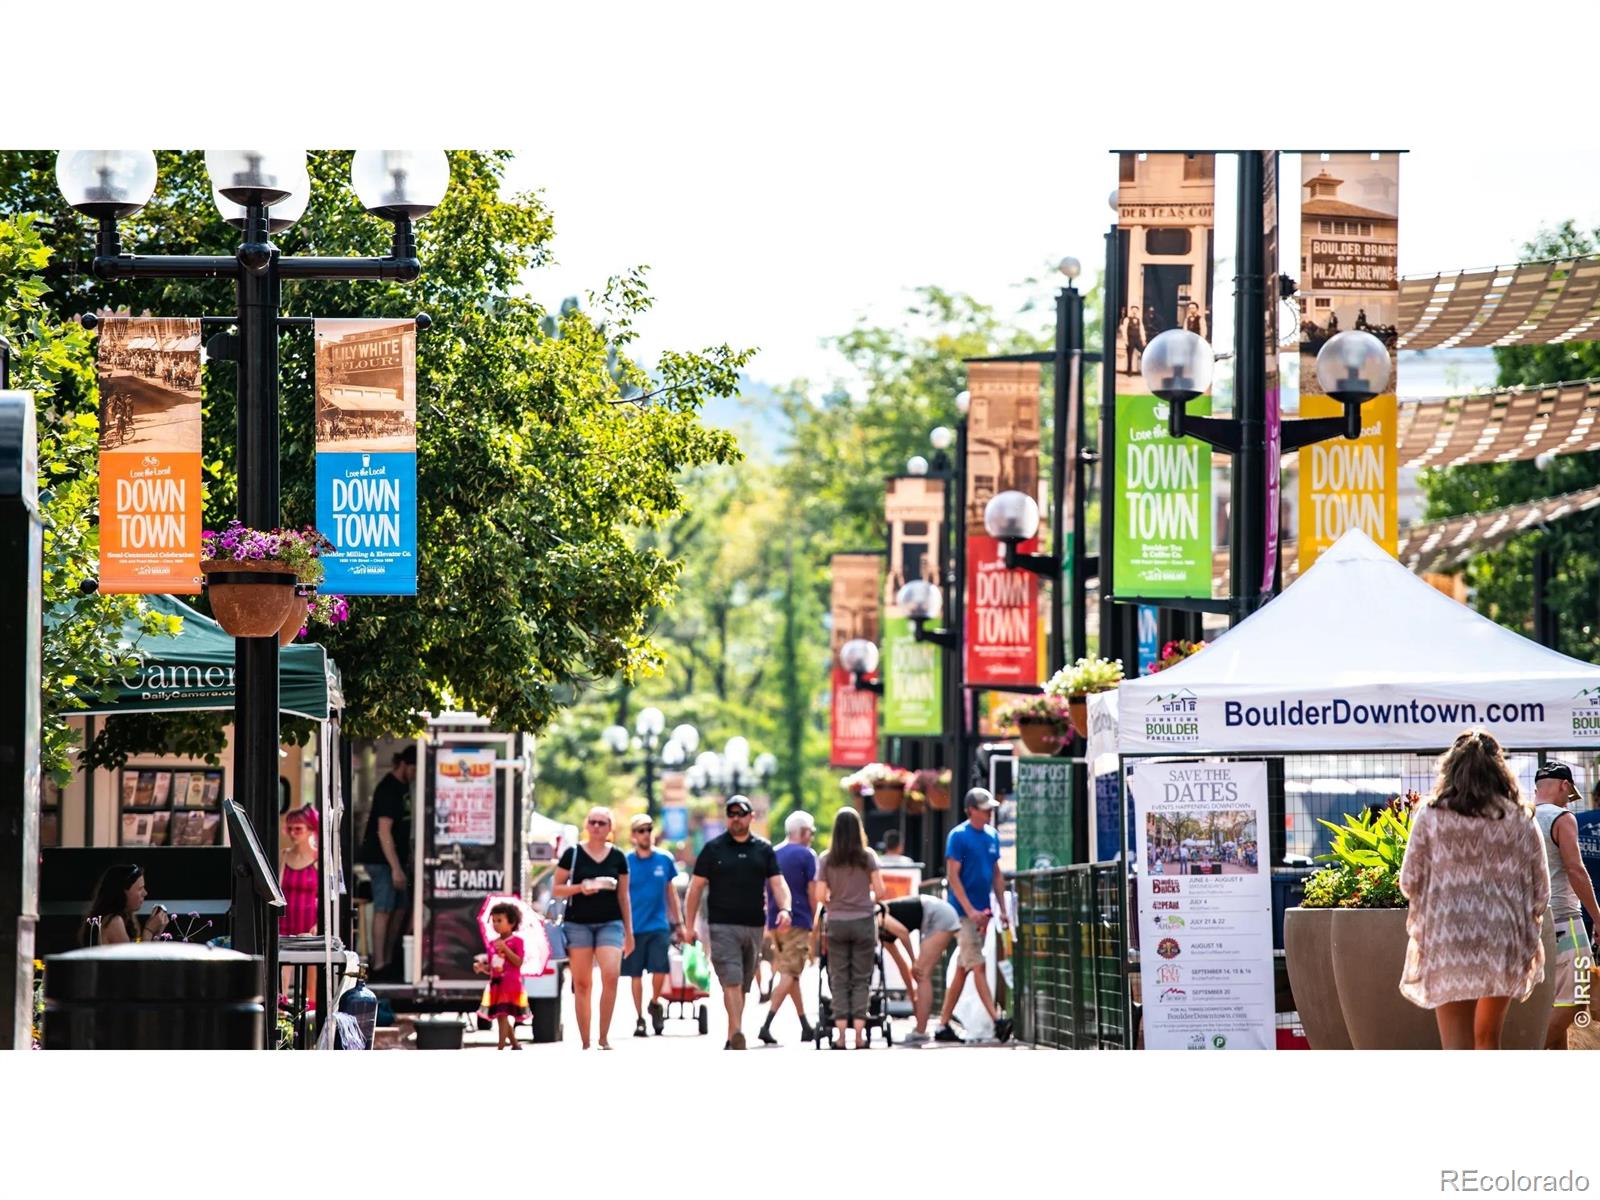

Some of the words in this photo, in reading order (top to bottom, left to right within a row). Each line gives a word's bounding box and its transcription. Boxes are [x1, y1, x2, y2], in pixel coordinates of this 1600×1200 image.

[1313, 241, 1361, 256] BOULDER
[1356, 265, 1393, 281] BREWING
[335, 344, 357, 361] LILY
[358, 339, 400, 359] WHITE
[341, 356, 393, 370] FLOUR
[1130, 427, 1153, 441] Love
[1360, 420, 1382, 438] ocal
[129, 468, 144, 478] Love
[345, 469, 359, 478] Love
[369, 465, 386, 476] Local
[1127, 443, 1199, 491] DOWN
[1312, 445, 1385, 491] DOWN
[116, 478, 186, 513] DOWN
[332, 478, 400, 512] DOWN
[1126, 491, 1199, 541] TOWN
[1311, 494, 1385, 542] TOWN
[116, 513, 186, 548] TOWN
[332, 513, 400, 548] TOWN
[346, 551, 368, 559] Milling
[975, 571, 1031, 607] DOWN
[974, 606, 1031, 644] TOWN
[1224, 698, 1546, 728] BoulderDowntown.com
[1145, 723, 1199, 735] BOULDER
[1019, 763, 1071, 780] COMPOST
[1169, 769, 1201, 782] SAVE
[1203, 769, 1231, 781] THE
[1018, 781, 1070, 798] COMPOST
[1163, 782, 1239, 803] DATES
[434, 869, 457, 889] WE
[459, 869, 505, 889] PARTY
[1167, 1012, 1247, 1020] BoulderDowntown.com
